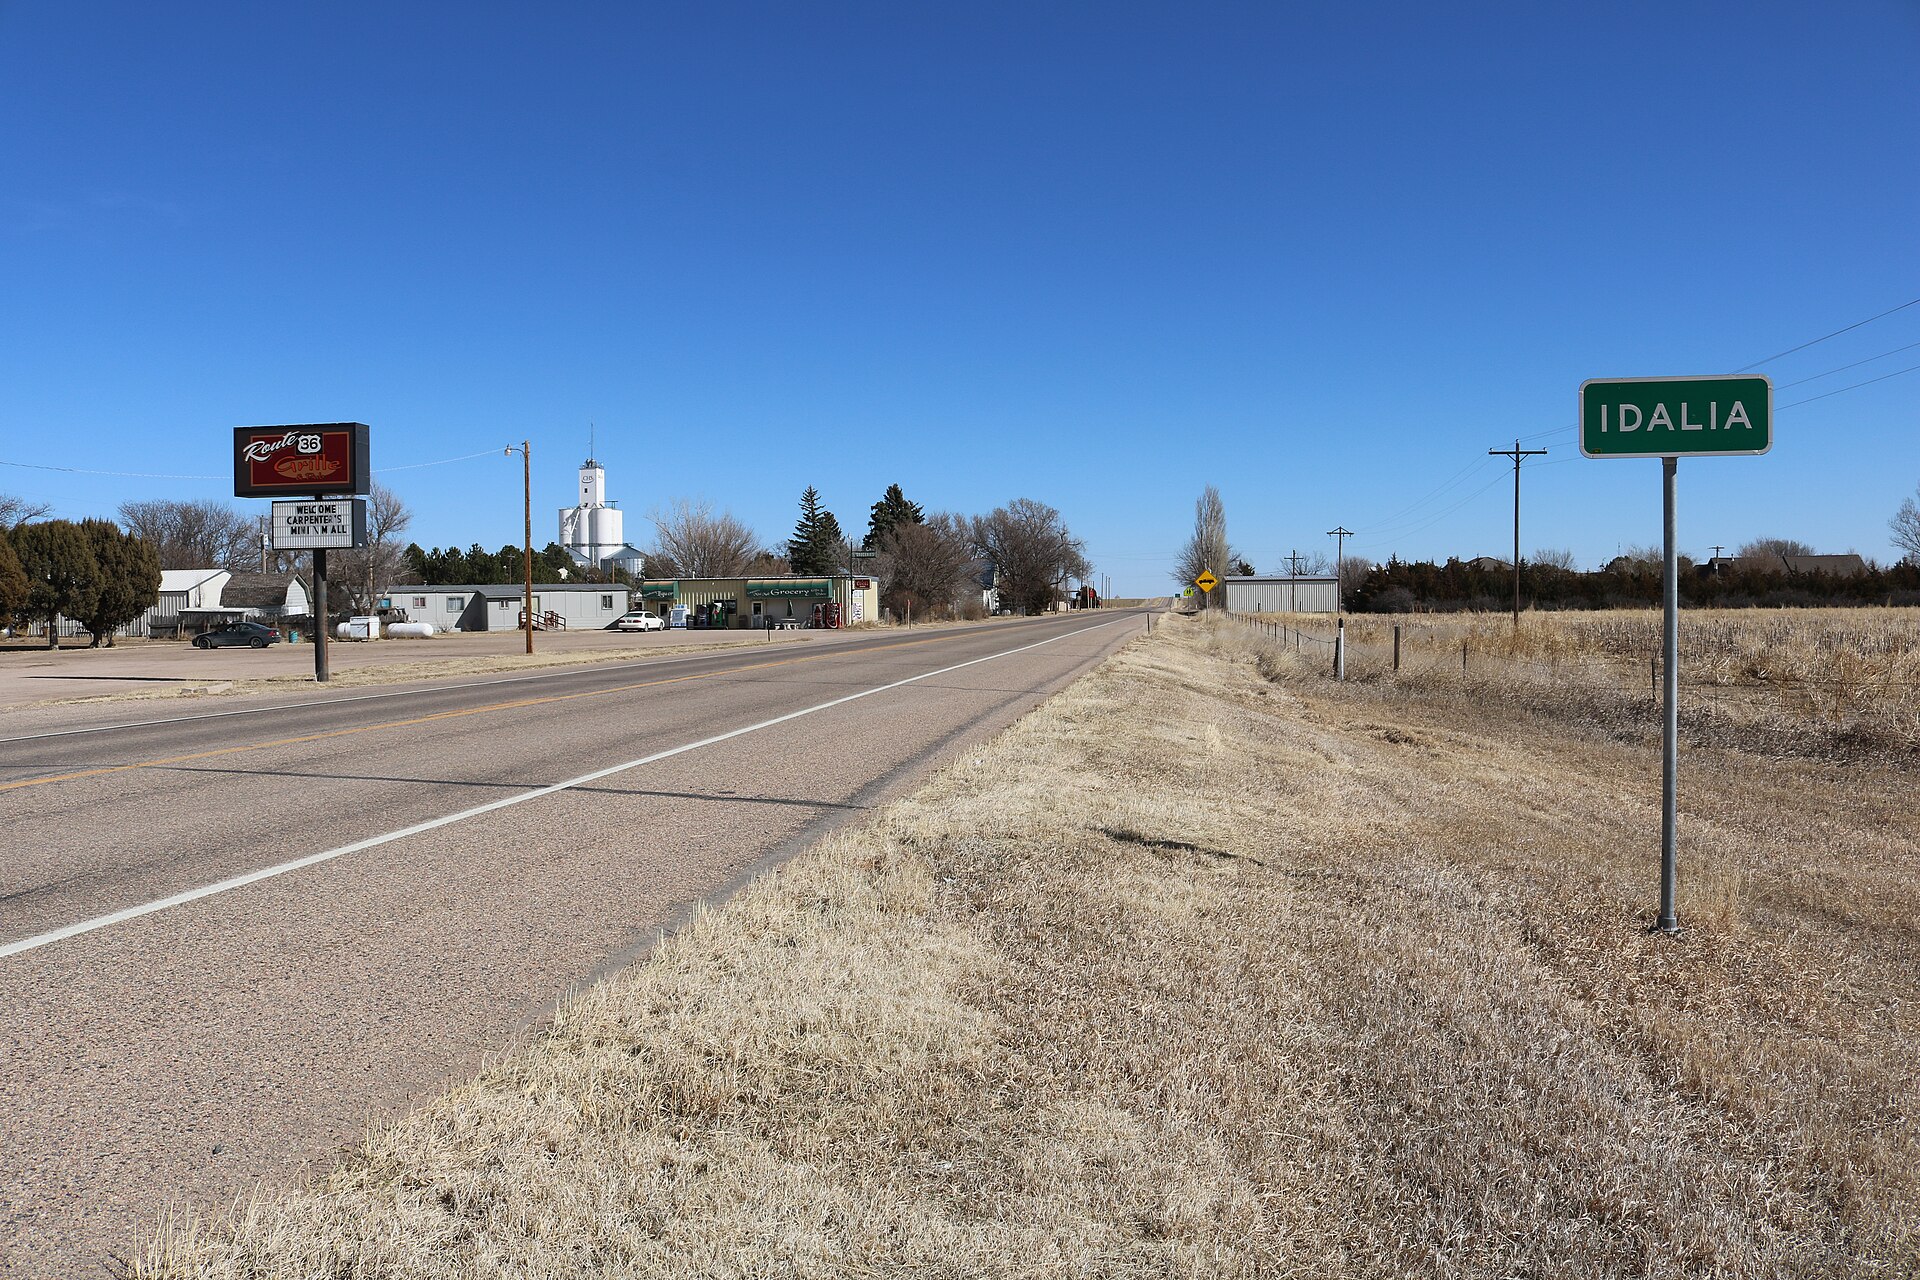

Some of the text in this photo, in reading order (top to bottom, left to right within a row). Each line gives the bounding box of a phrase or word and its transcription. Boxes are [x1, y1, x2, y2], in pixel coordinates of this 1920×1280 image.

[1601, 401, 1753, 433] IDALIA
[243, 430, 318, 462] Route 36
[274, 454, 342, 473] Grille
[286, 515, 342, 525] CARPENTER'S
[290, 525, 310, 535] MINI
[321, 525, 347, 535] MALL
[770, 588, 809, 597] Grocery
